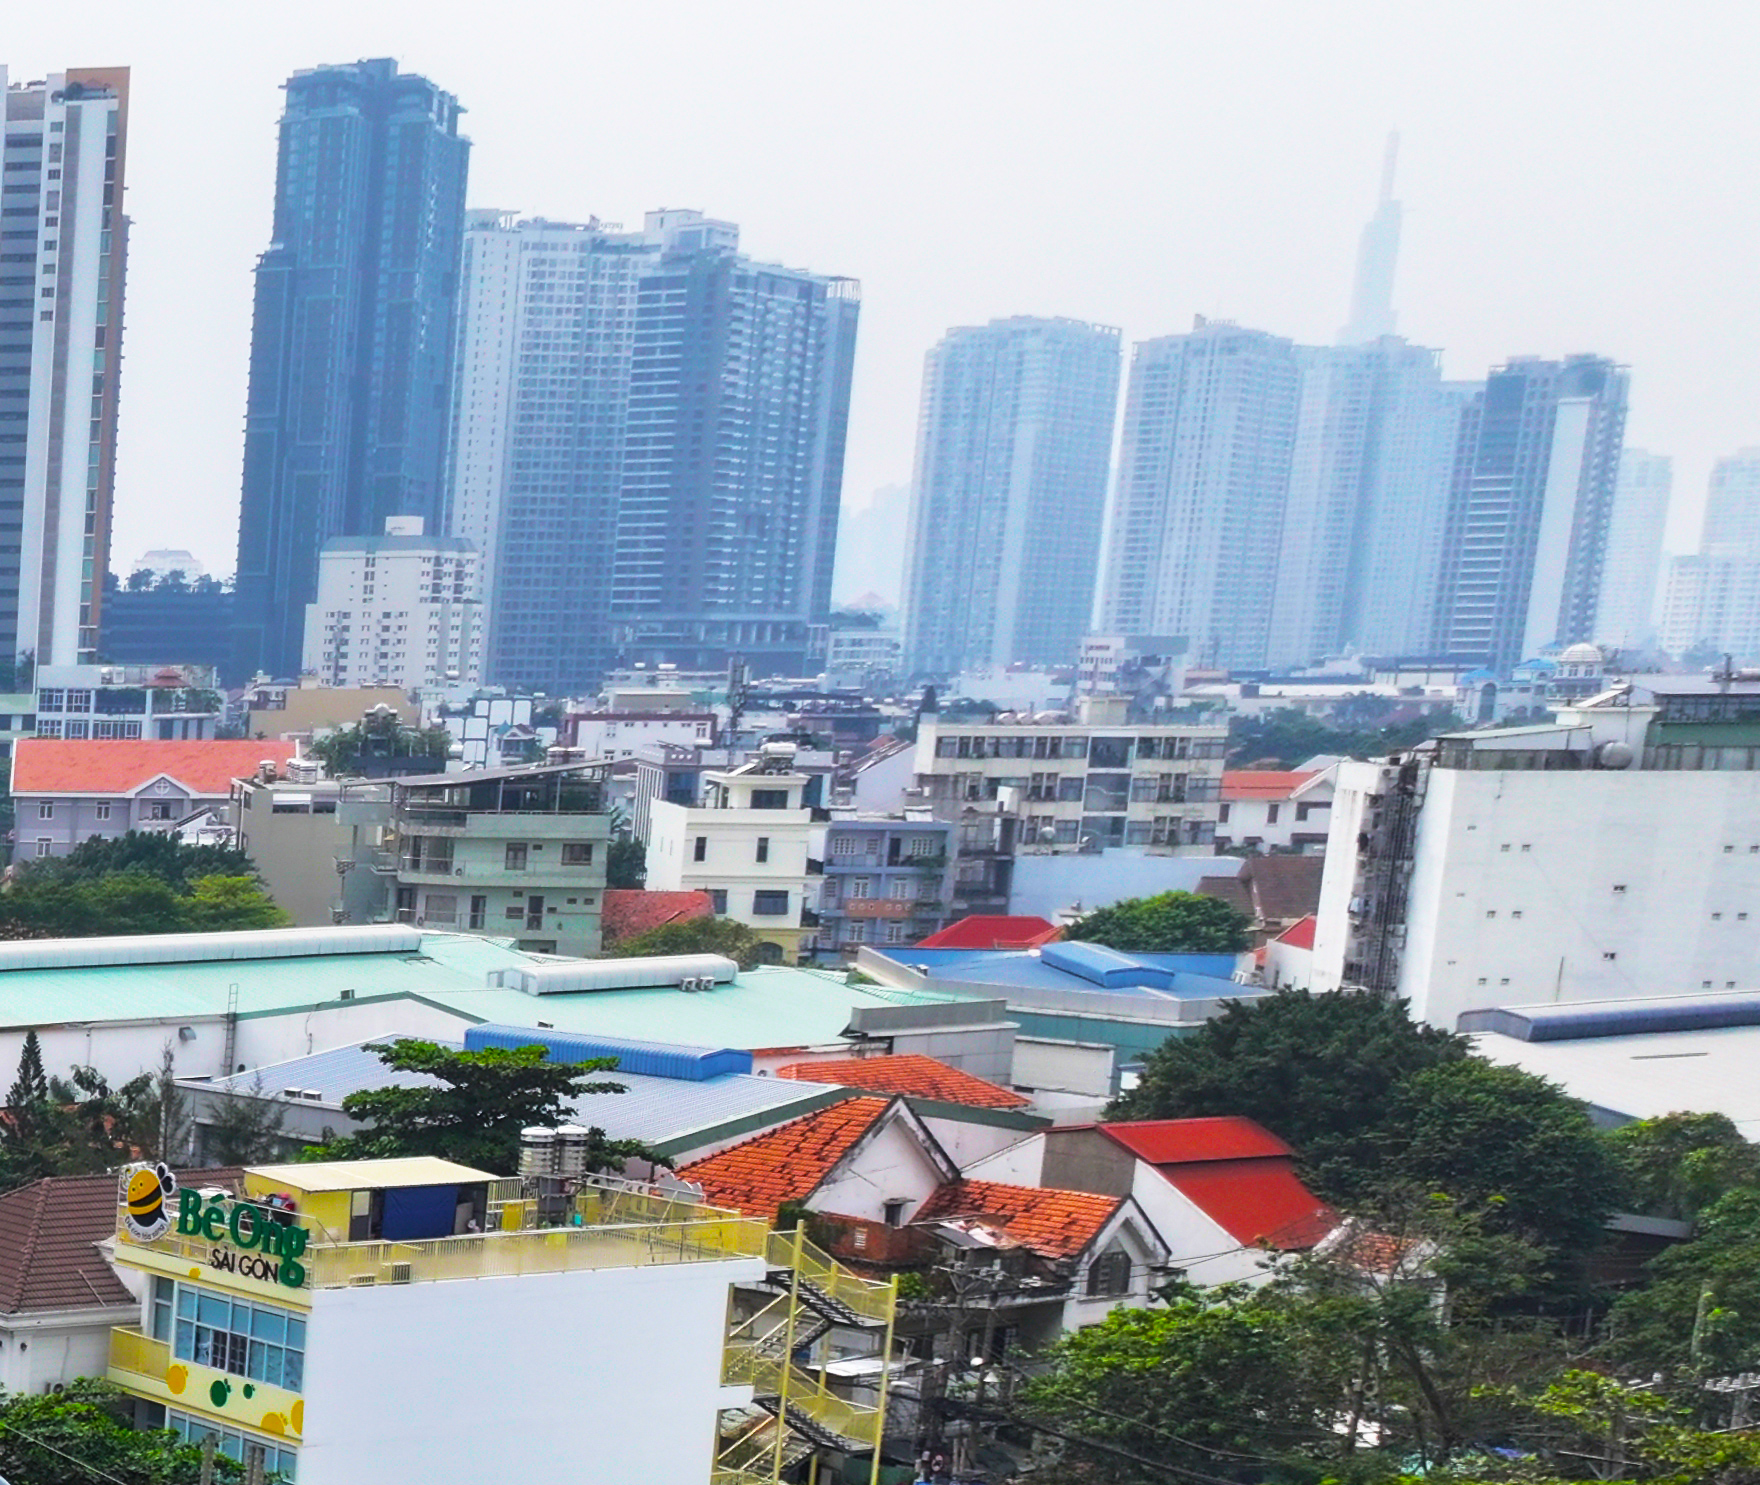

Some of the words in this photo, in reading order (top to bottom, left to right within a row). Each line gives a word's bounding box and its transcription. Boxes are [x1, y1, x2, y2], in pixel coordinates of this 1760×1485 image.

[176, 1187, 225, 1241] Bé
[230, 1203, 309, 1288] Ong
[211, 1246, 235, 1273] SÀI
[238, 1254, 279, 1284] GÒN
